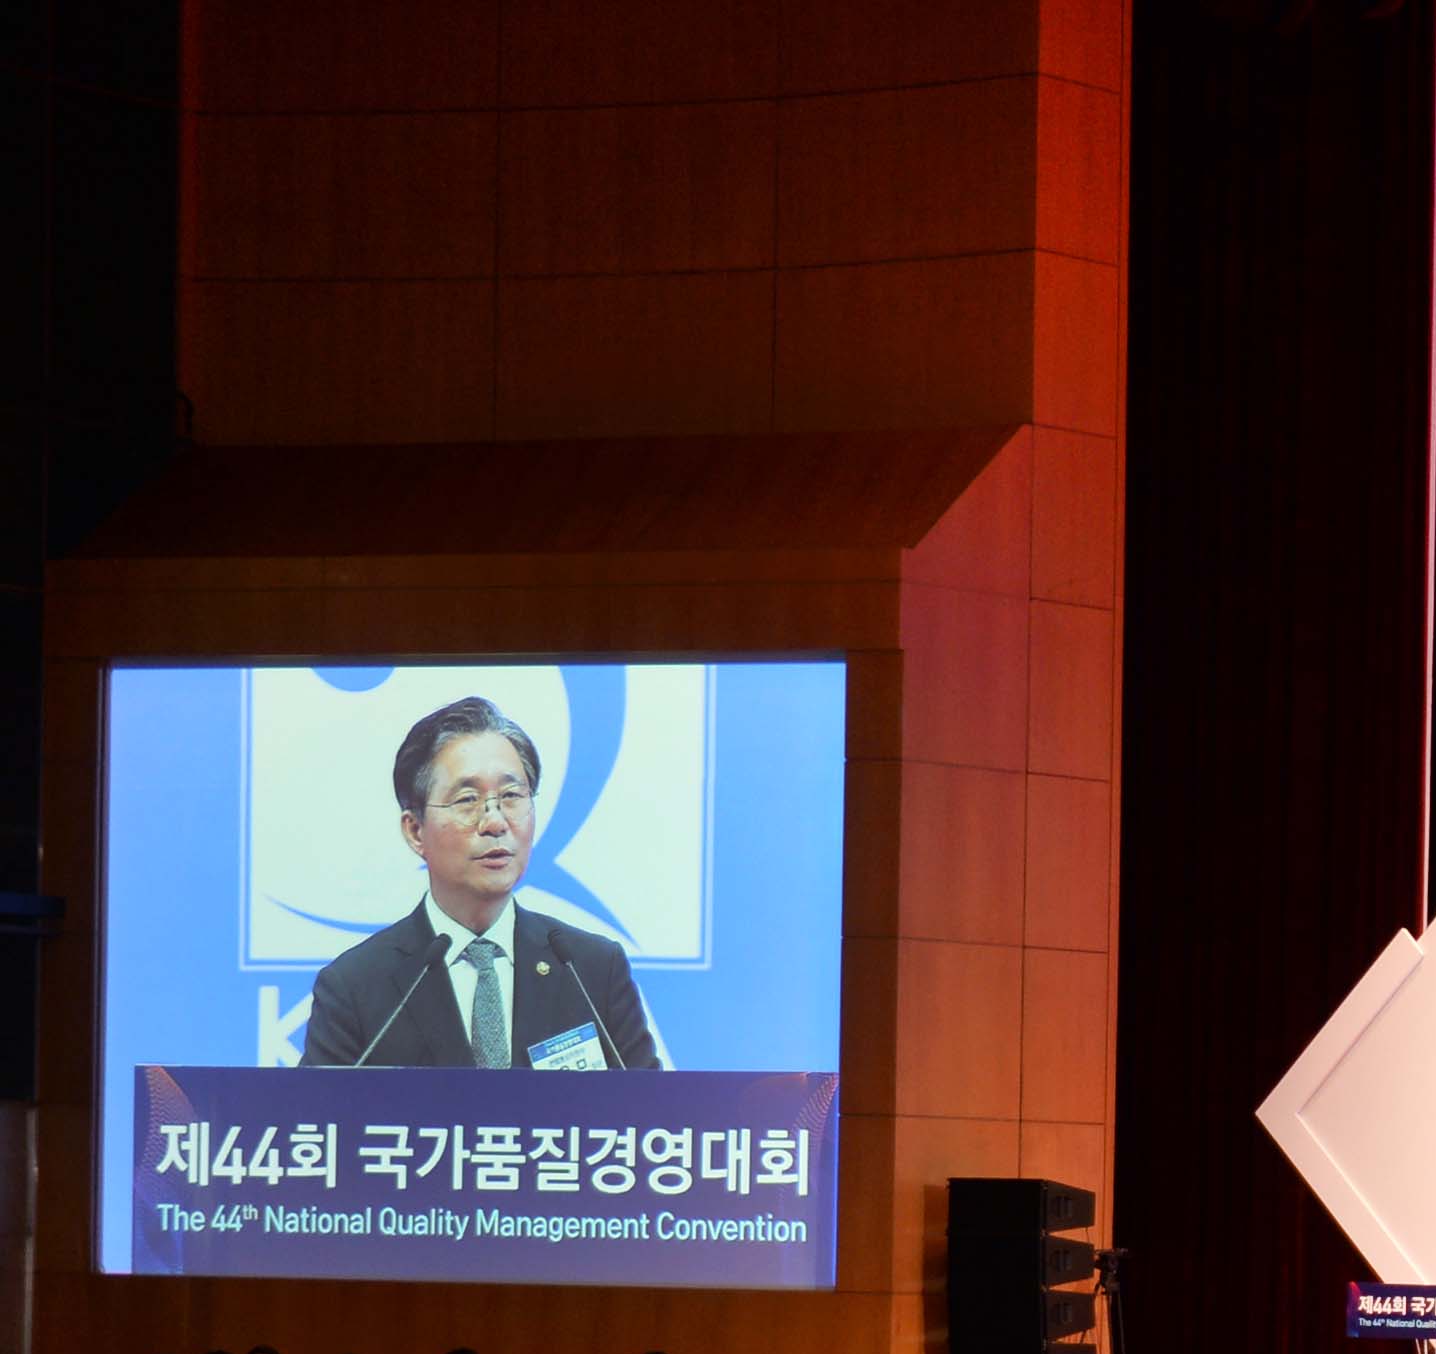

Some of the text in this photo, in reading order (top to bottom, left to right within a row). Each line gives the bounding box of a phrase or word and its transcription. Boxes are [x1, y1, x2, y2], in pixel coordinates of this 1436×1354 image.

[156, 1122, 808, 1196] 제44회 국가품질경영대회
[156, 1202, 807, 1242] The 44th National Quality Management Convention
[1358, 1295, 1407, 1315] 제44회
